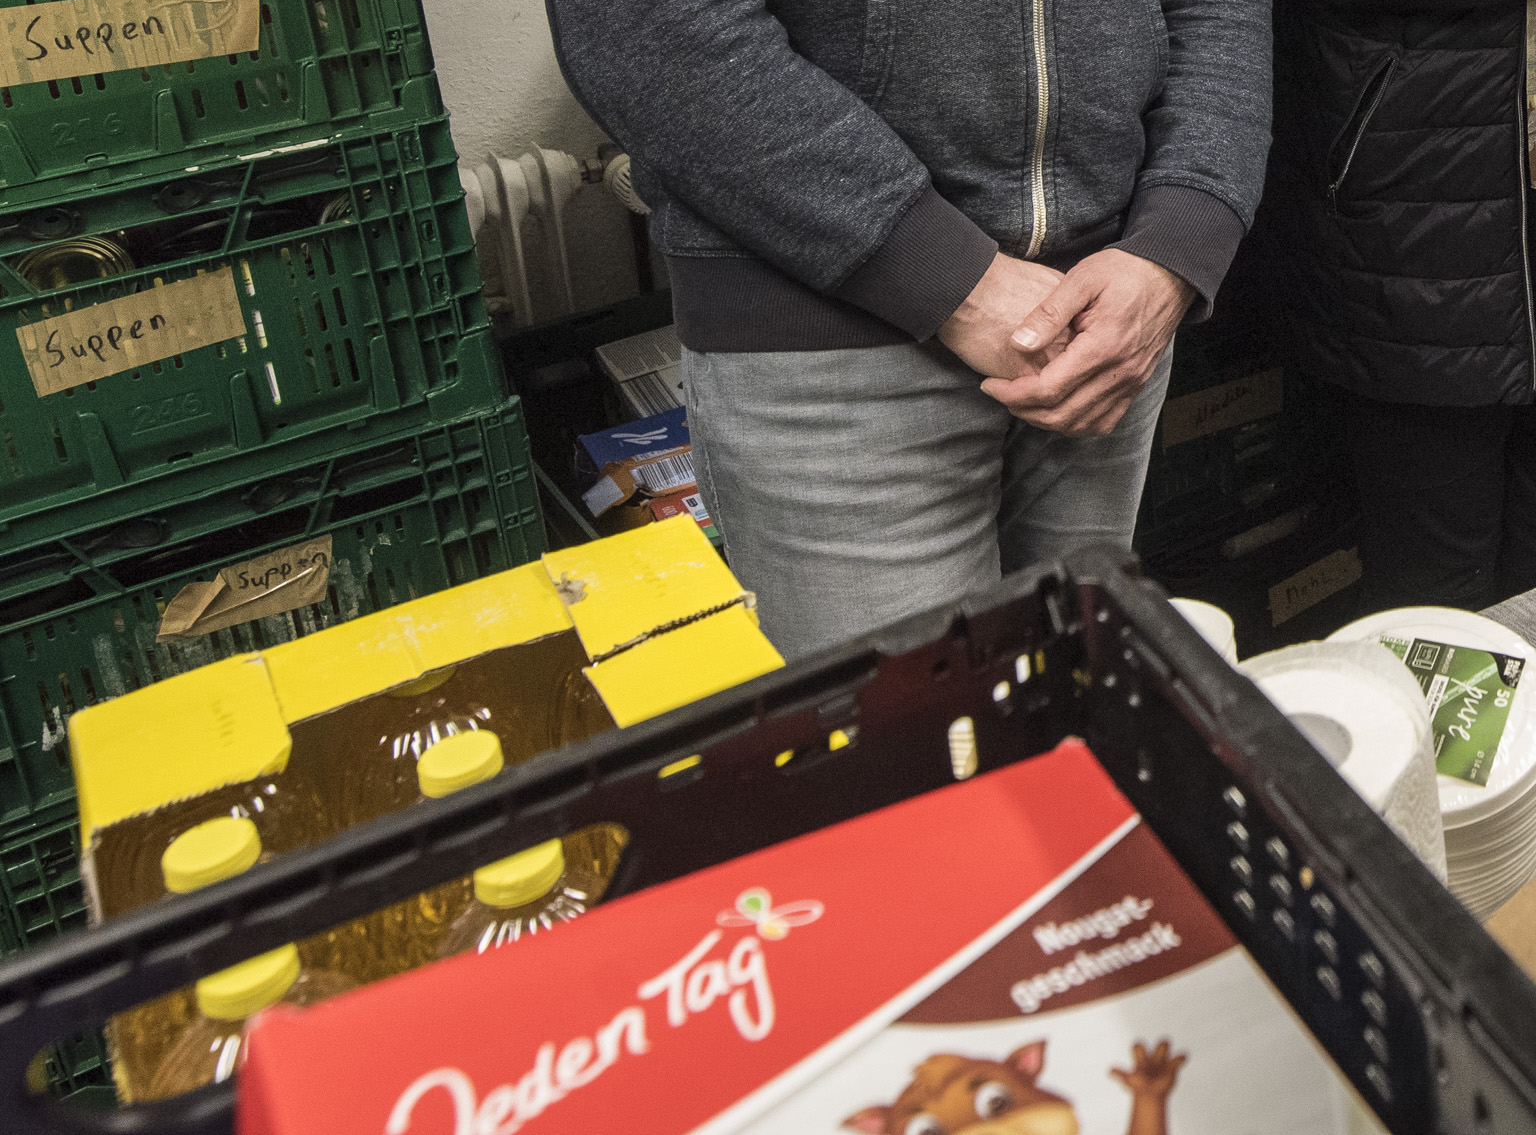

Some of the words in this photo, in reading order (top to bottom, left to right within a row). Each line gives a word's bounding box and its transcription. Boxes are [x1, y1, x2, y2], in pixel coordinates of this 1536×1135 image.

[25, 16, 164, 61] Suppen
[45, 314, 166, 368] Suppen
[1448, 677, 1489, 742] pure
[1493, 688, 1511, 708] 50
[1031, 894, 1155, 956] Nougat-
[1009, 921, 1183, 1014] geschmack
[384, 1005, 652, 1135] Jeden
[637, 927, 776, 1043] Tag
